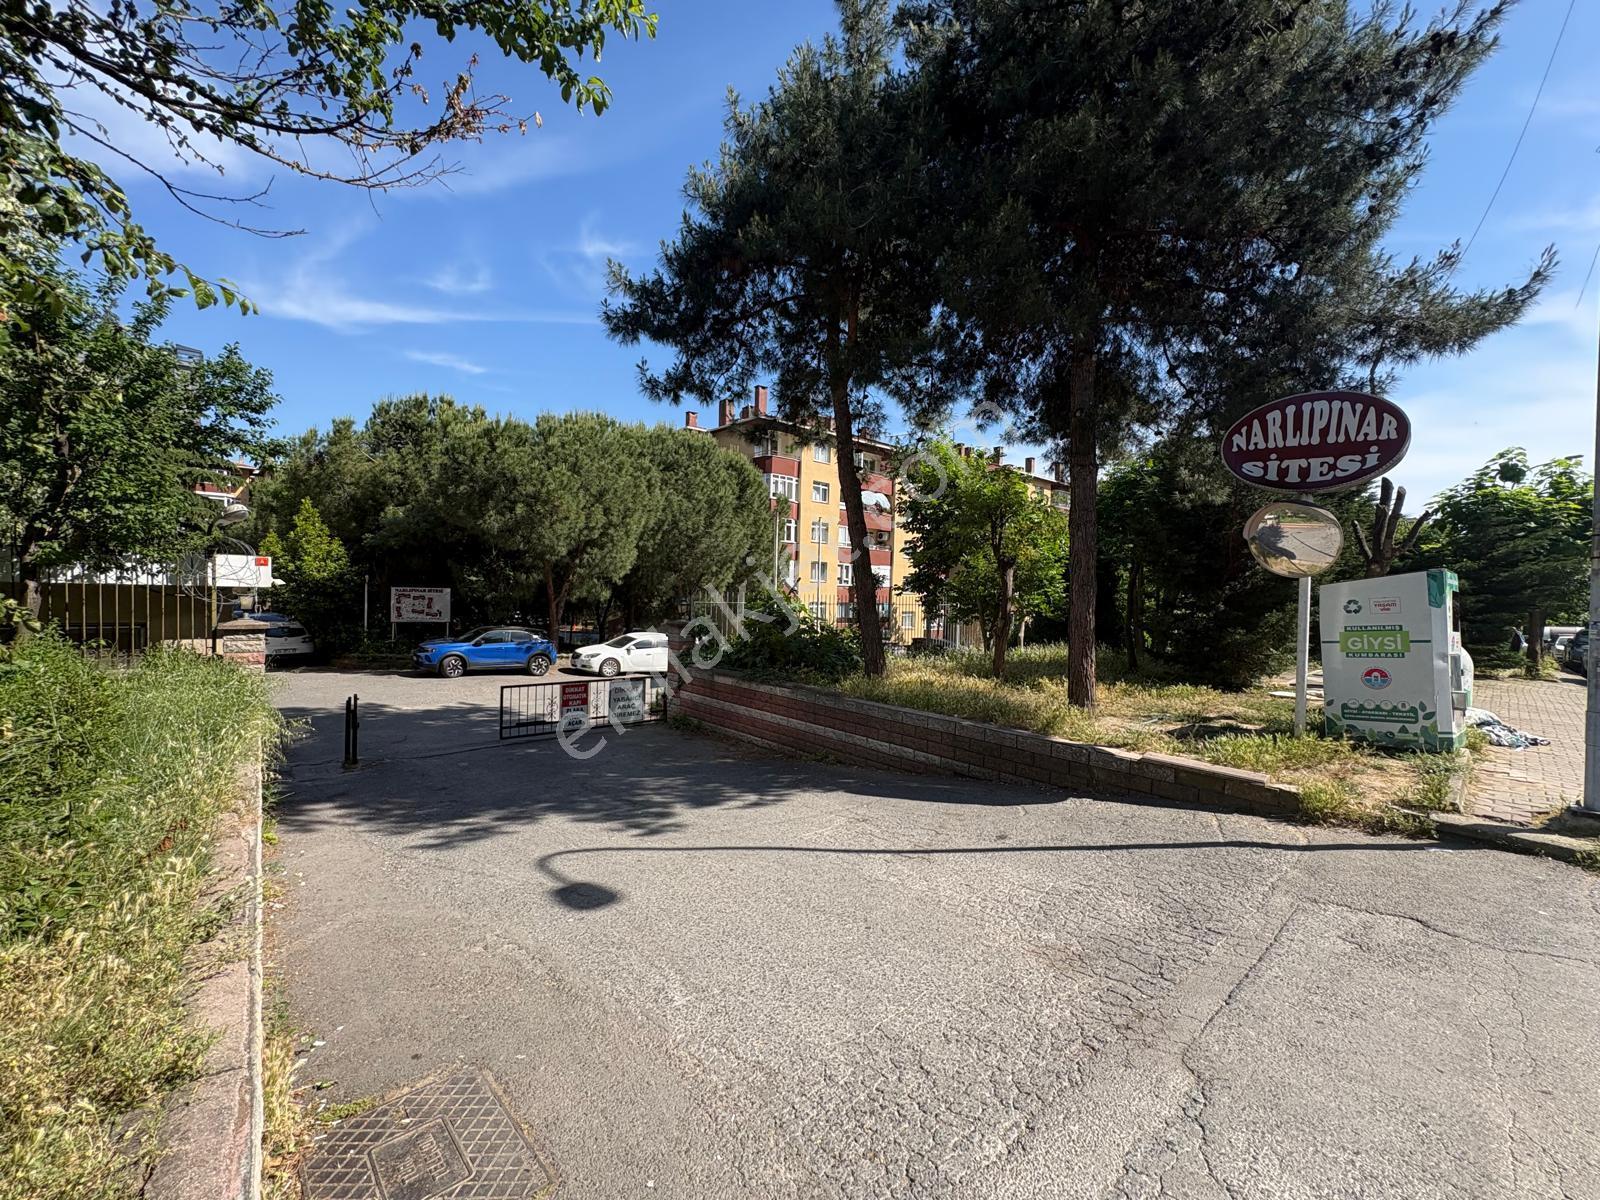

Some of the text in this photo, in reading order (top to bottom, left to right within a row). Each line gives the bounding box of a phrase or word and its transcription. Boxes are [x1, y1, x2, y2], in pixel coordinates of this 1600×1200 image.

[1231, 400, 1398, 452] NARLIPINAR
[1241, 445, 1381, 483] SİTESİ
[1347, 633, 1402, 650] GİYSİ
